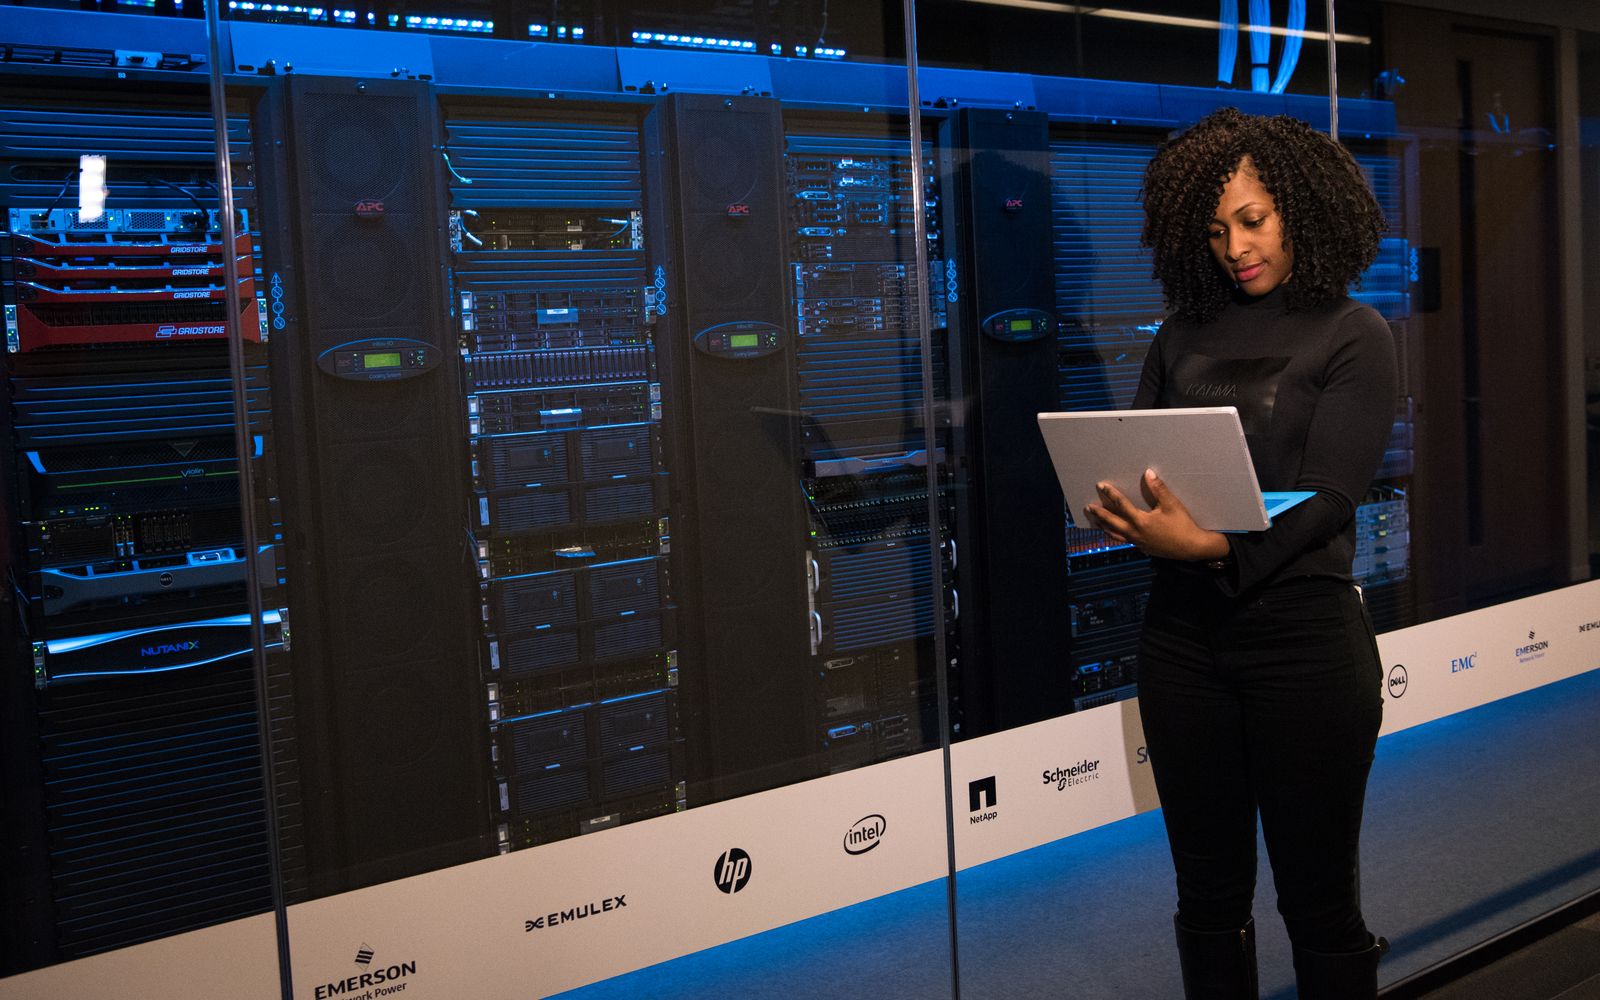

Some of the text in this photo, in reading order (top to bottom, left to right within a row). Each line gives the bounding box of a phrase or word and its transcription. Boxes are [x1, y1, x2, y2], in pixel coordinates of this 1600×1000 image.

[356, 202, 384, 211] APC
[728, 205, 750, 213] APC
[1006, 199, 1023, 207] APC
[172, 268, 210, 276] GRIDSTORE
[173, 291, 211, 299] GRIDSTORE
[178, 325, 225, 335] GRIDSTORE
[1185, 383, 1238, 397] KARMA
[181, 467, 205, 477] Violin
[141, 640, 200, 657] NUTANIX
[1515, 641, 1549, 657] EMERSON
[1390, 676, 1406, 687] DELL
[1042, 760, 1100, 785] Schneider
[1067, 772, 1100, 787] Electric
[970, 811, 998, 825] NetApp
[849, 822, 879, 845] intel
[718, 849, 749, 894] hp
[547, 894, 627, 927] EMULEX
[314, 960, 416, 1000] EMERSON
[374, 982, 407, 998] Power
